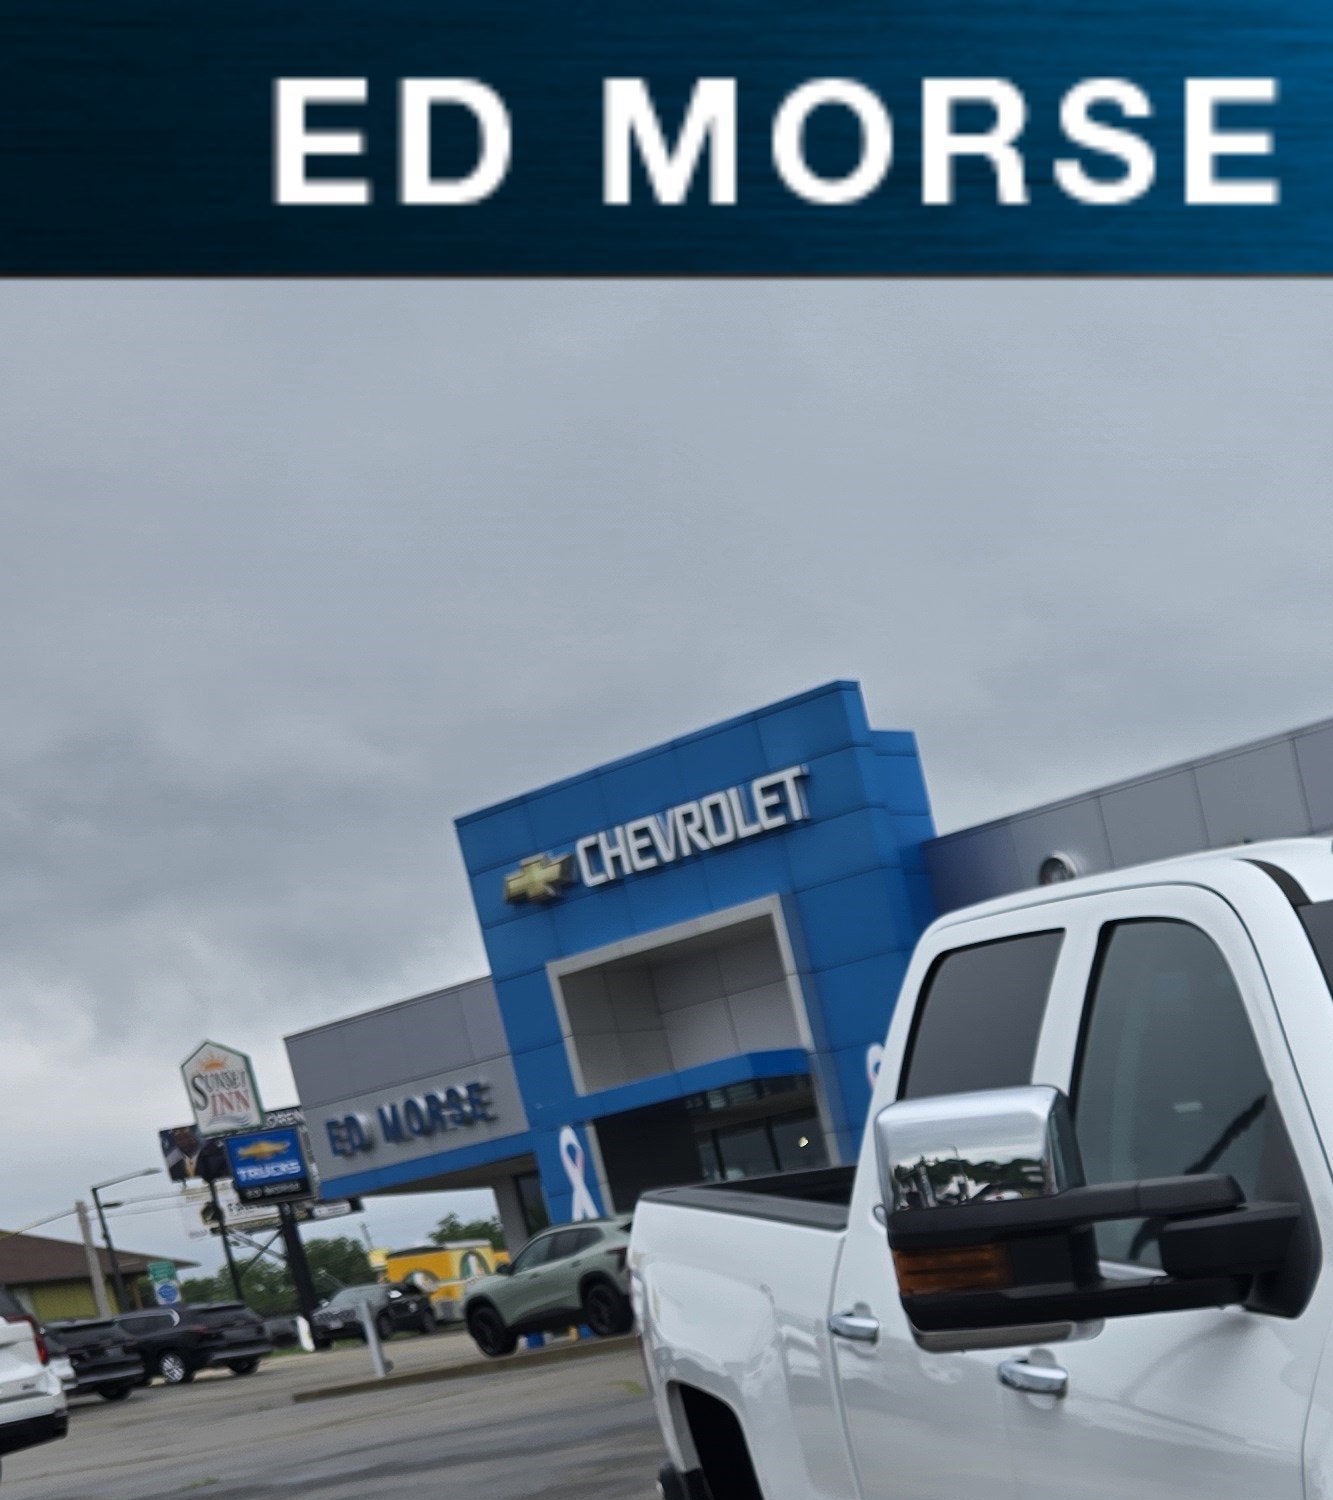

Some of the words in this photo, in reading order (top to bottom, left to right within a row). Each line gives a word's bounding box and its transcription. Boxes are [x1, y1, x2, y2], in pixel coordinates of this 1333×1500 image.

[576, 765, 809, 887] CHEVROLET
[211, 1090, 250, 1117] INN
[326, 1115, 368, 1157] ED
[378, 1083, 496, 1143] MORSE
